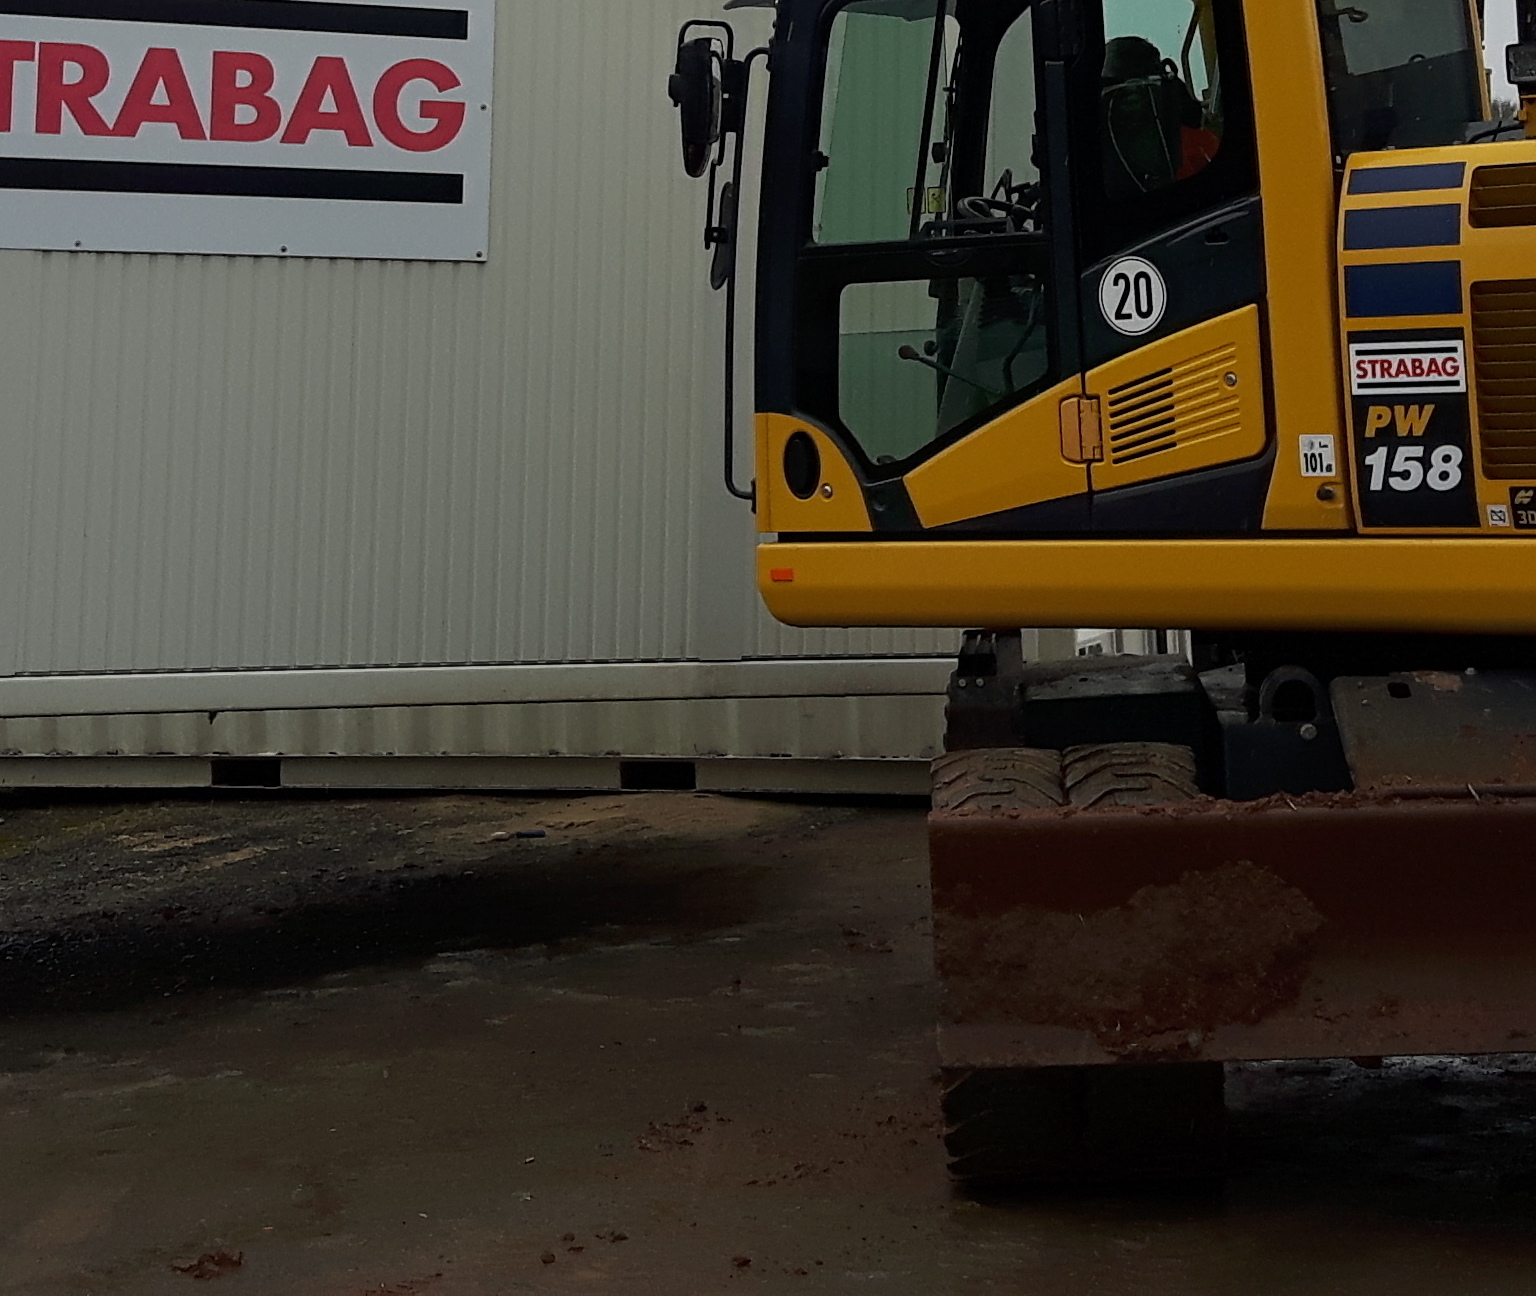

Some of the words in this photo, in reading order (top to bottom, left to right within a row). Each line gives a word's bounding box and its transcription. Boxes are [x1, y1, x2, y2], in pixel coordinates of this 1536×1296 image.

[1113, 271, 1153, 320] 20
[1356, 356, 1460, 379] STRABAG
[1365, 404, 1435, 437] PW
[1303, 452, 1324, 473] 101
[1365, 444, 1463, 491] 158
